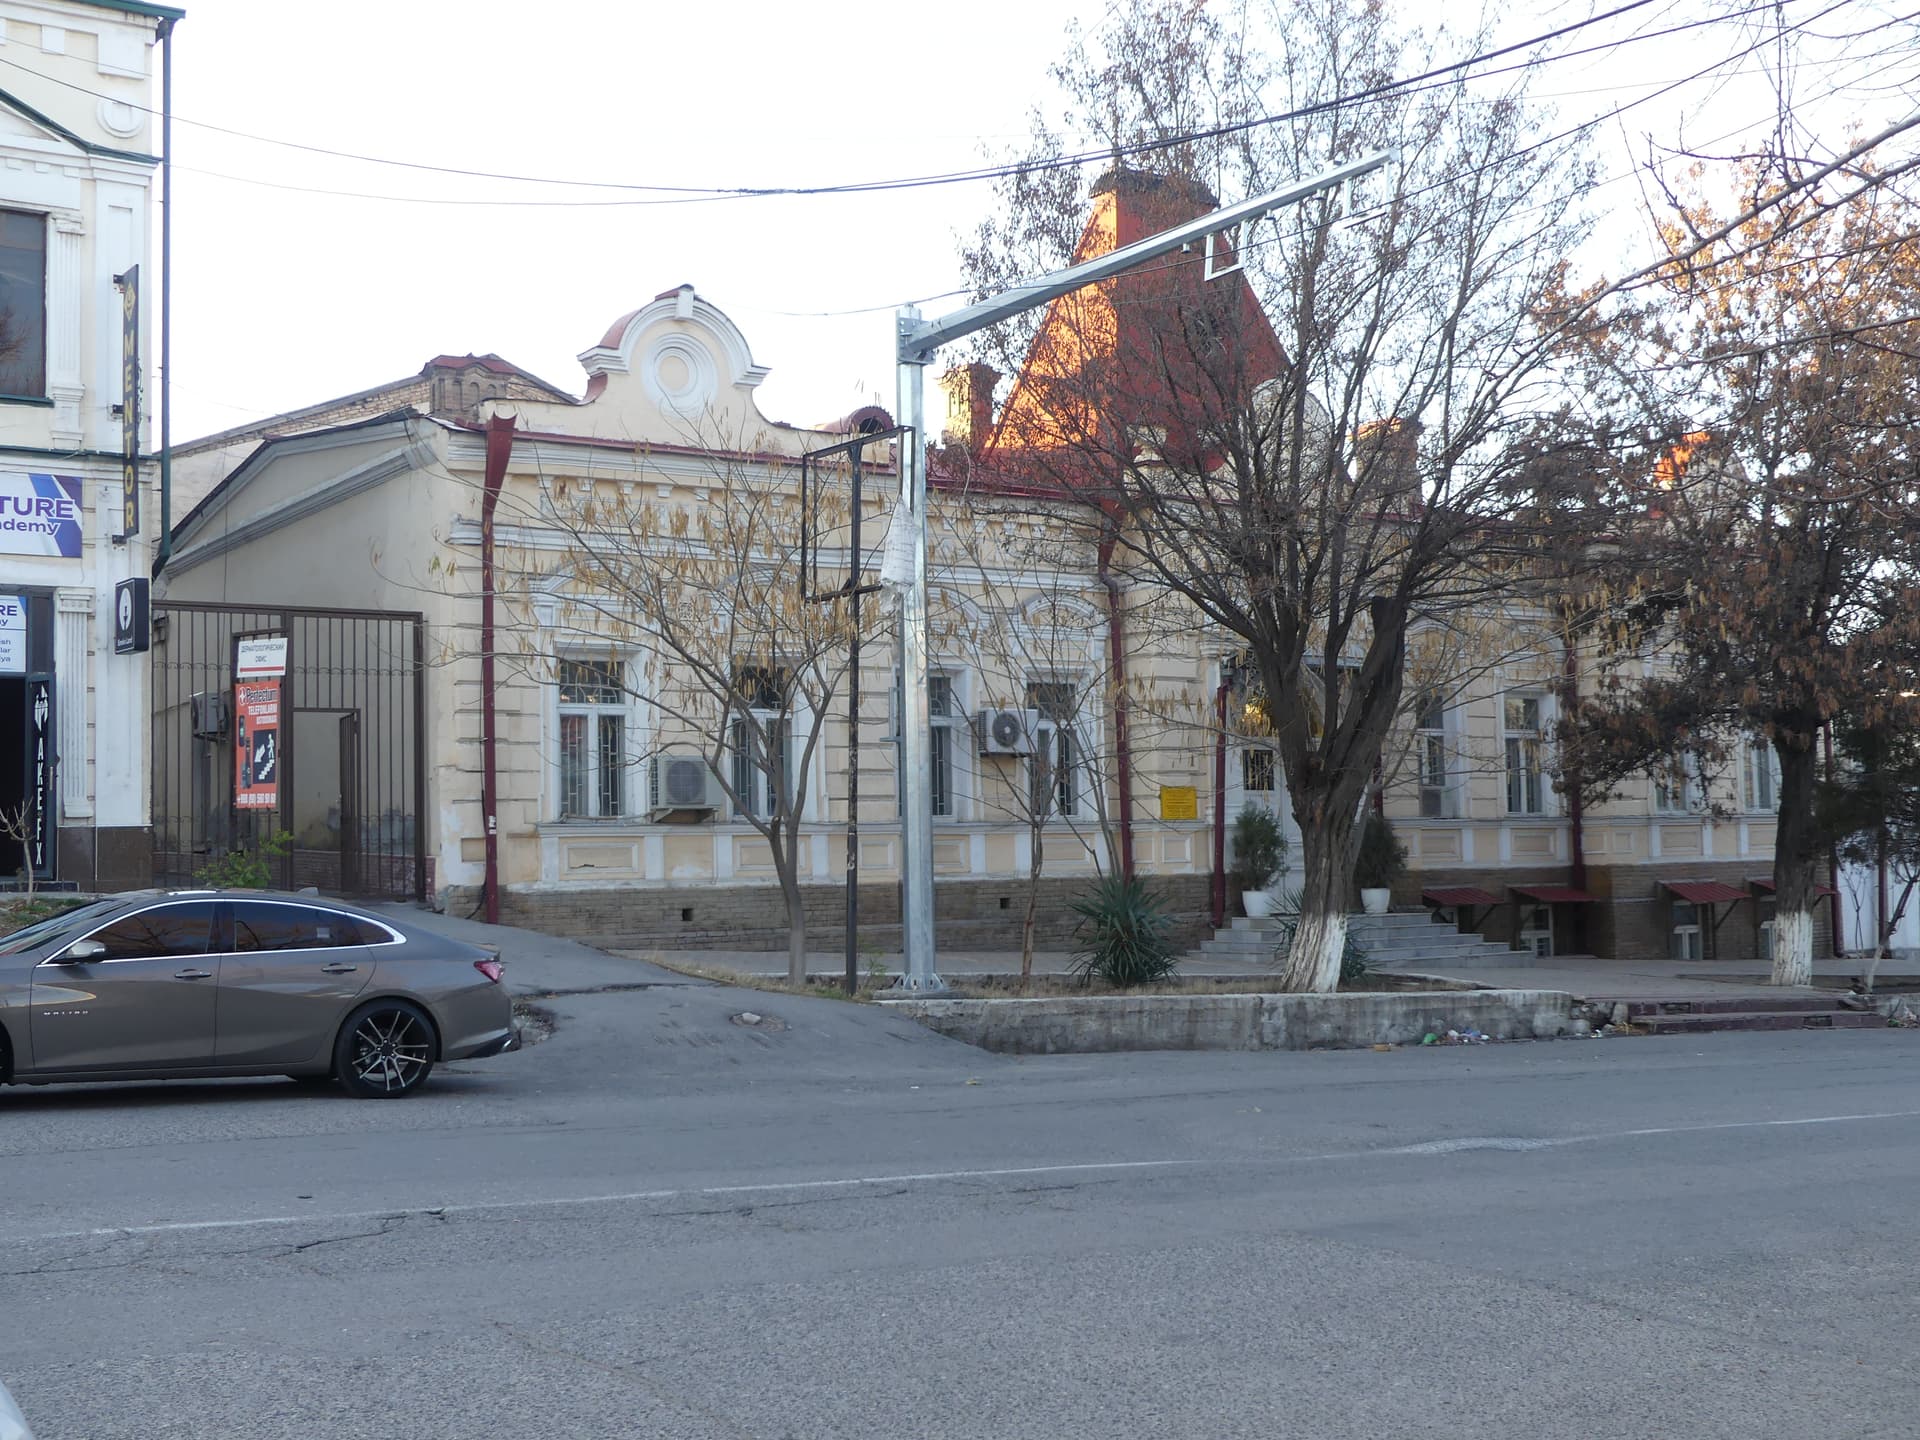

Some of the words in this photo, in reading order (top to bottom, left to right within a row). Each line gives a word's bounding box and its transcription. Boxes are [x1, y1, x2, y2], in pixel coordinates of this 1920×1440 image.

[123, 329, 135, 530] MENTOR
[0, 496, 74, 519] TURE
[0, 518, 59, 536] demy
[245, 687, 279, 704] Perfectum
